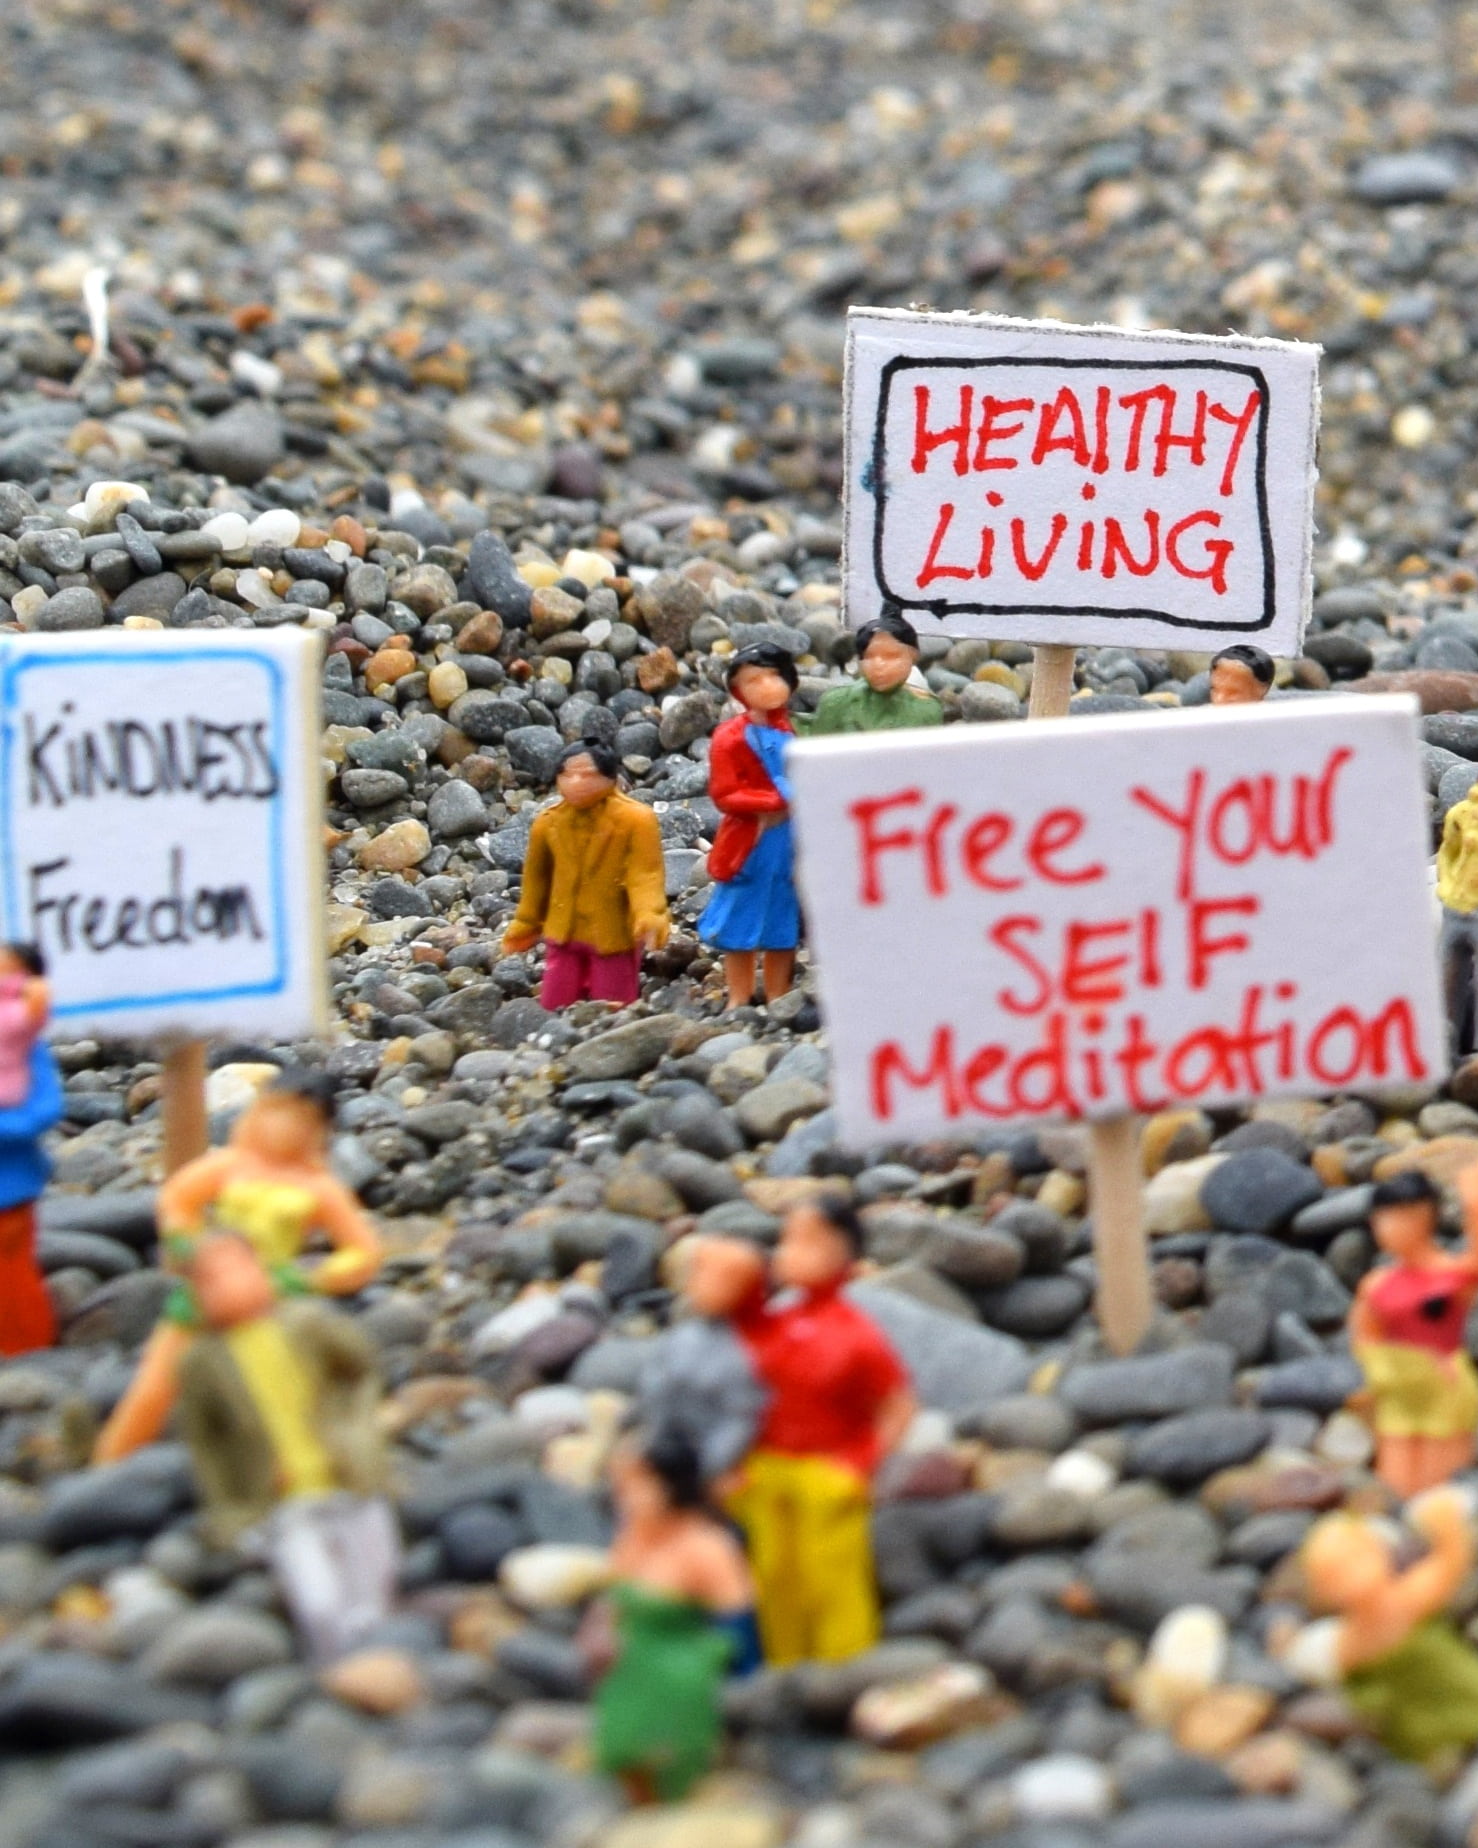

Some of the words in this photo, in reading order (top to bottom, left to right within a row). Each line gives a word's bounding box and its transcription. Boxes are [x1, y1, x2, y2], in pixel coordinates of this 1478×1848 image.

[916, 482, 1235, 595] LiViNG
[24, 702, 279, 808] KiNDNESS
[30, 847, 265, 954] Freedom
[847, 786, 1106, 905] Free
[868, 982, 1429, 1120] Meditation
